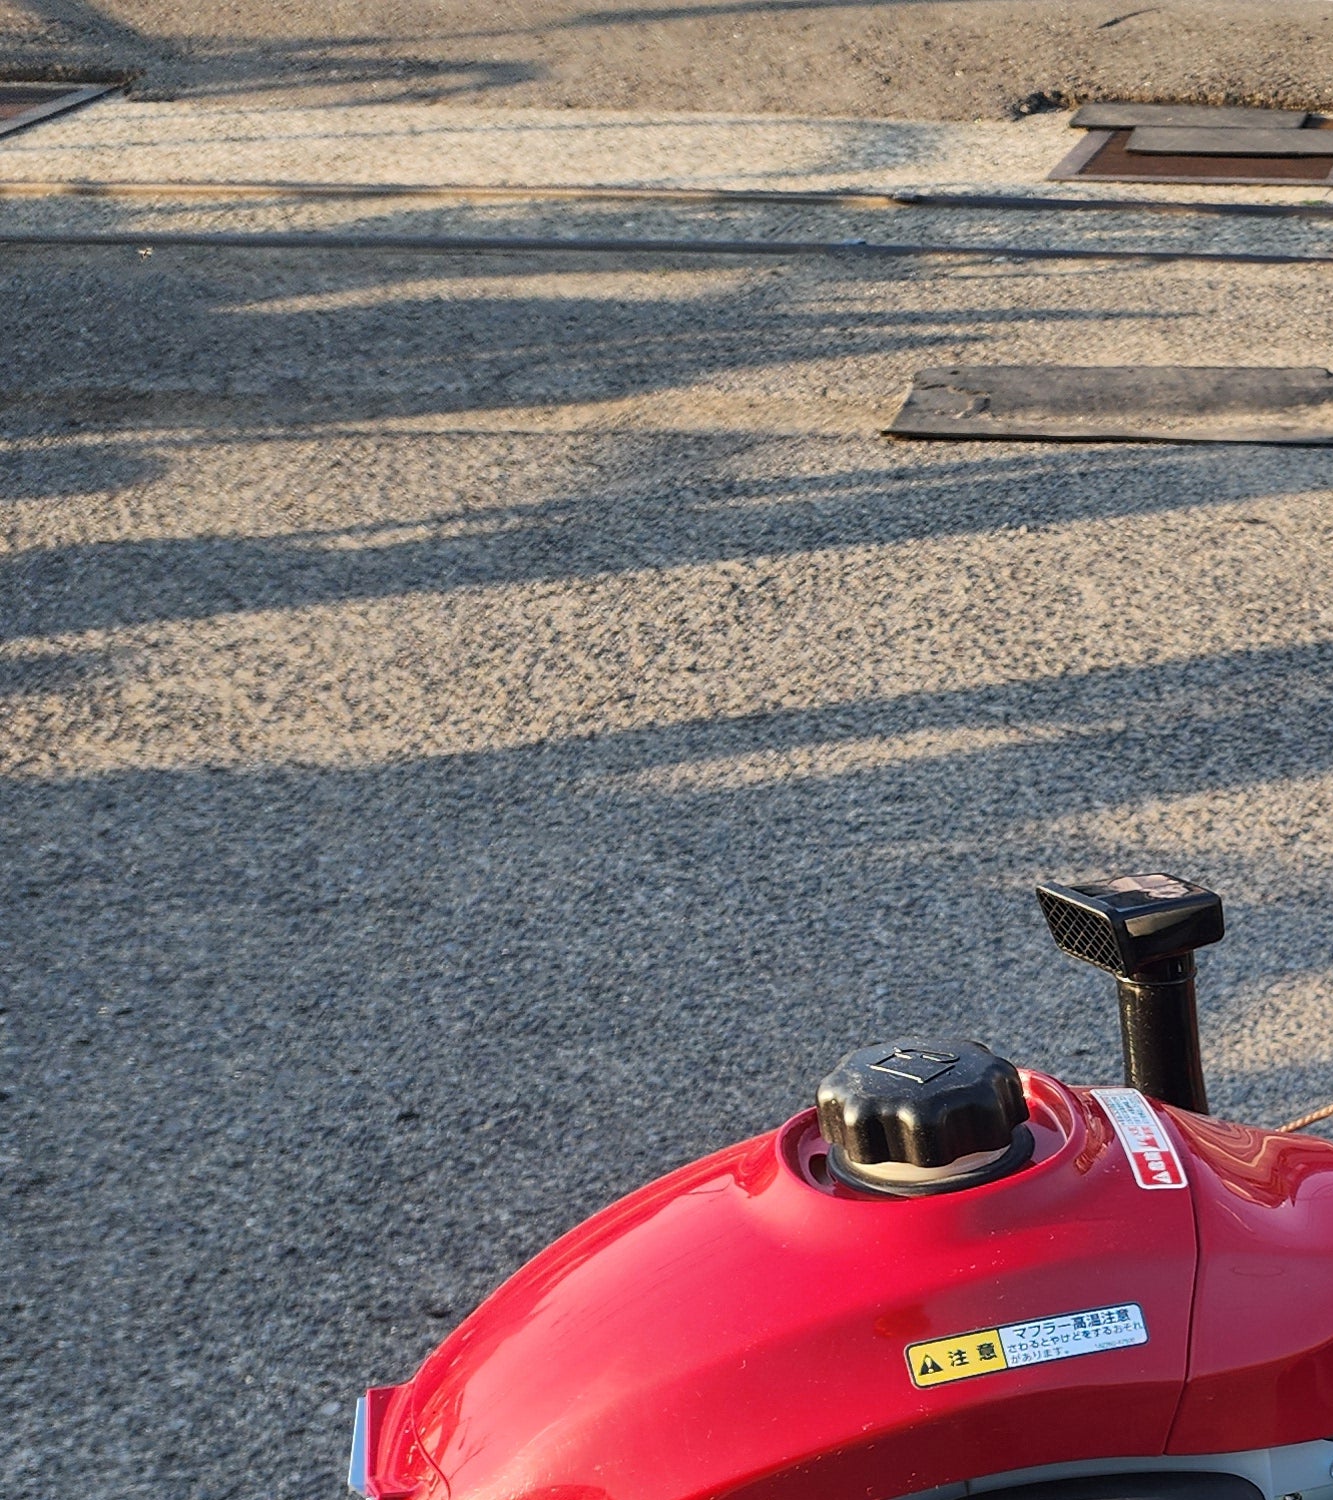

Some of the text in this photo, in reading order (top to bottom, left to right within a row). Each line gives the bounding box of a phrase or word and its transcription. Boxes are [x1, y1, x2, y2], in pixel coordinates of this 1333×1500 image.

[1007, 1322, 1143, 1353] さわるとやけどをするおそれ
[1013, 1308, 1131, 1339] マフラー高温注意
[948, 1342, 998, 1368] 注意
[1011, 1345, 1070, 1364] があります。
